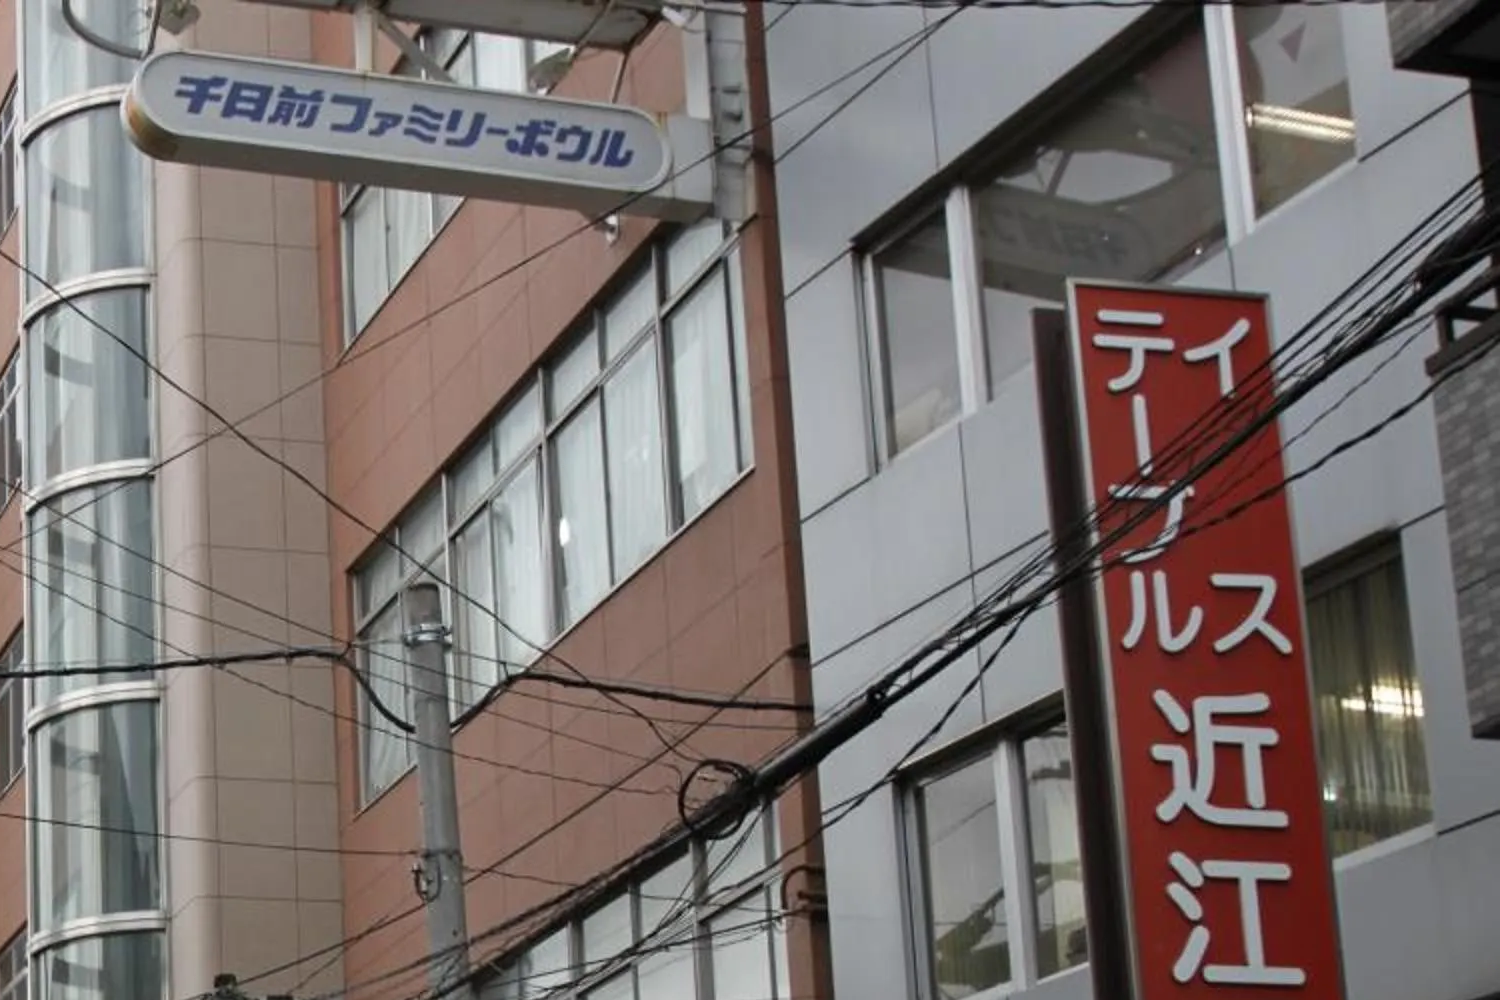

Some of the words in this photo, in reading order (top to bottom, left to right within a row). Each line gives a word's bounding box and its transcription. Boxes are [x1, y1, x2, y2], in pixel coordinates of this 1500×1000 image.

[175, 75, 634, 168] 千日前ファミリーボウル
